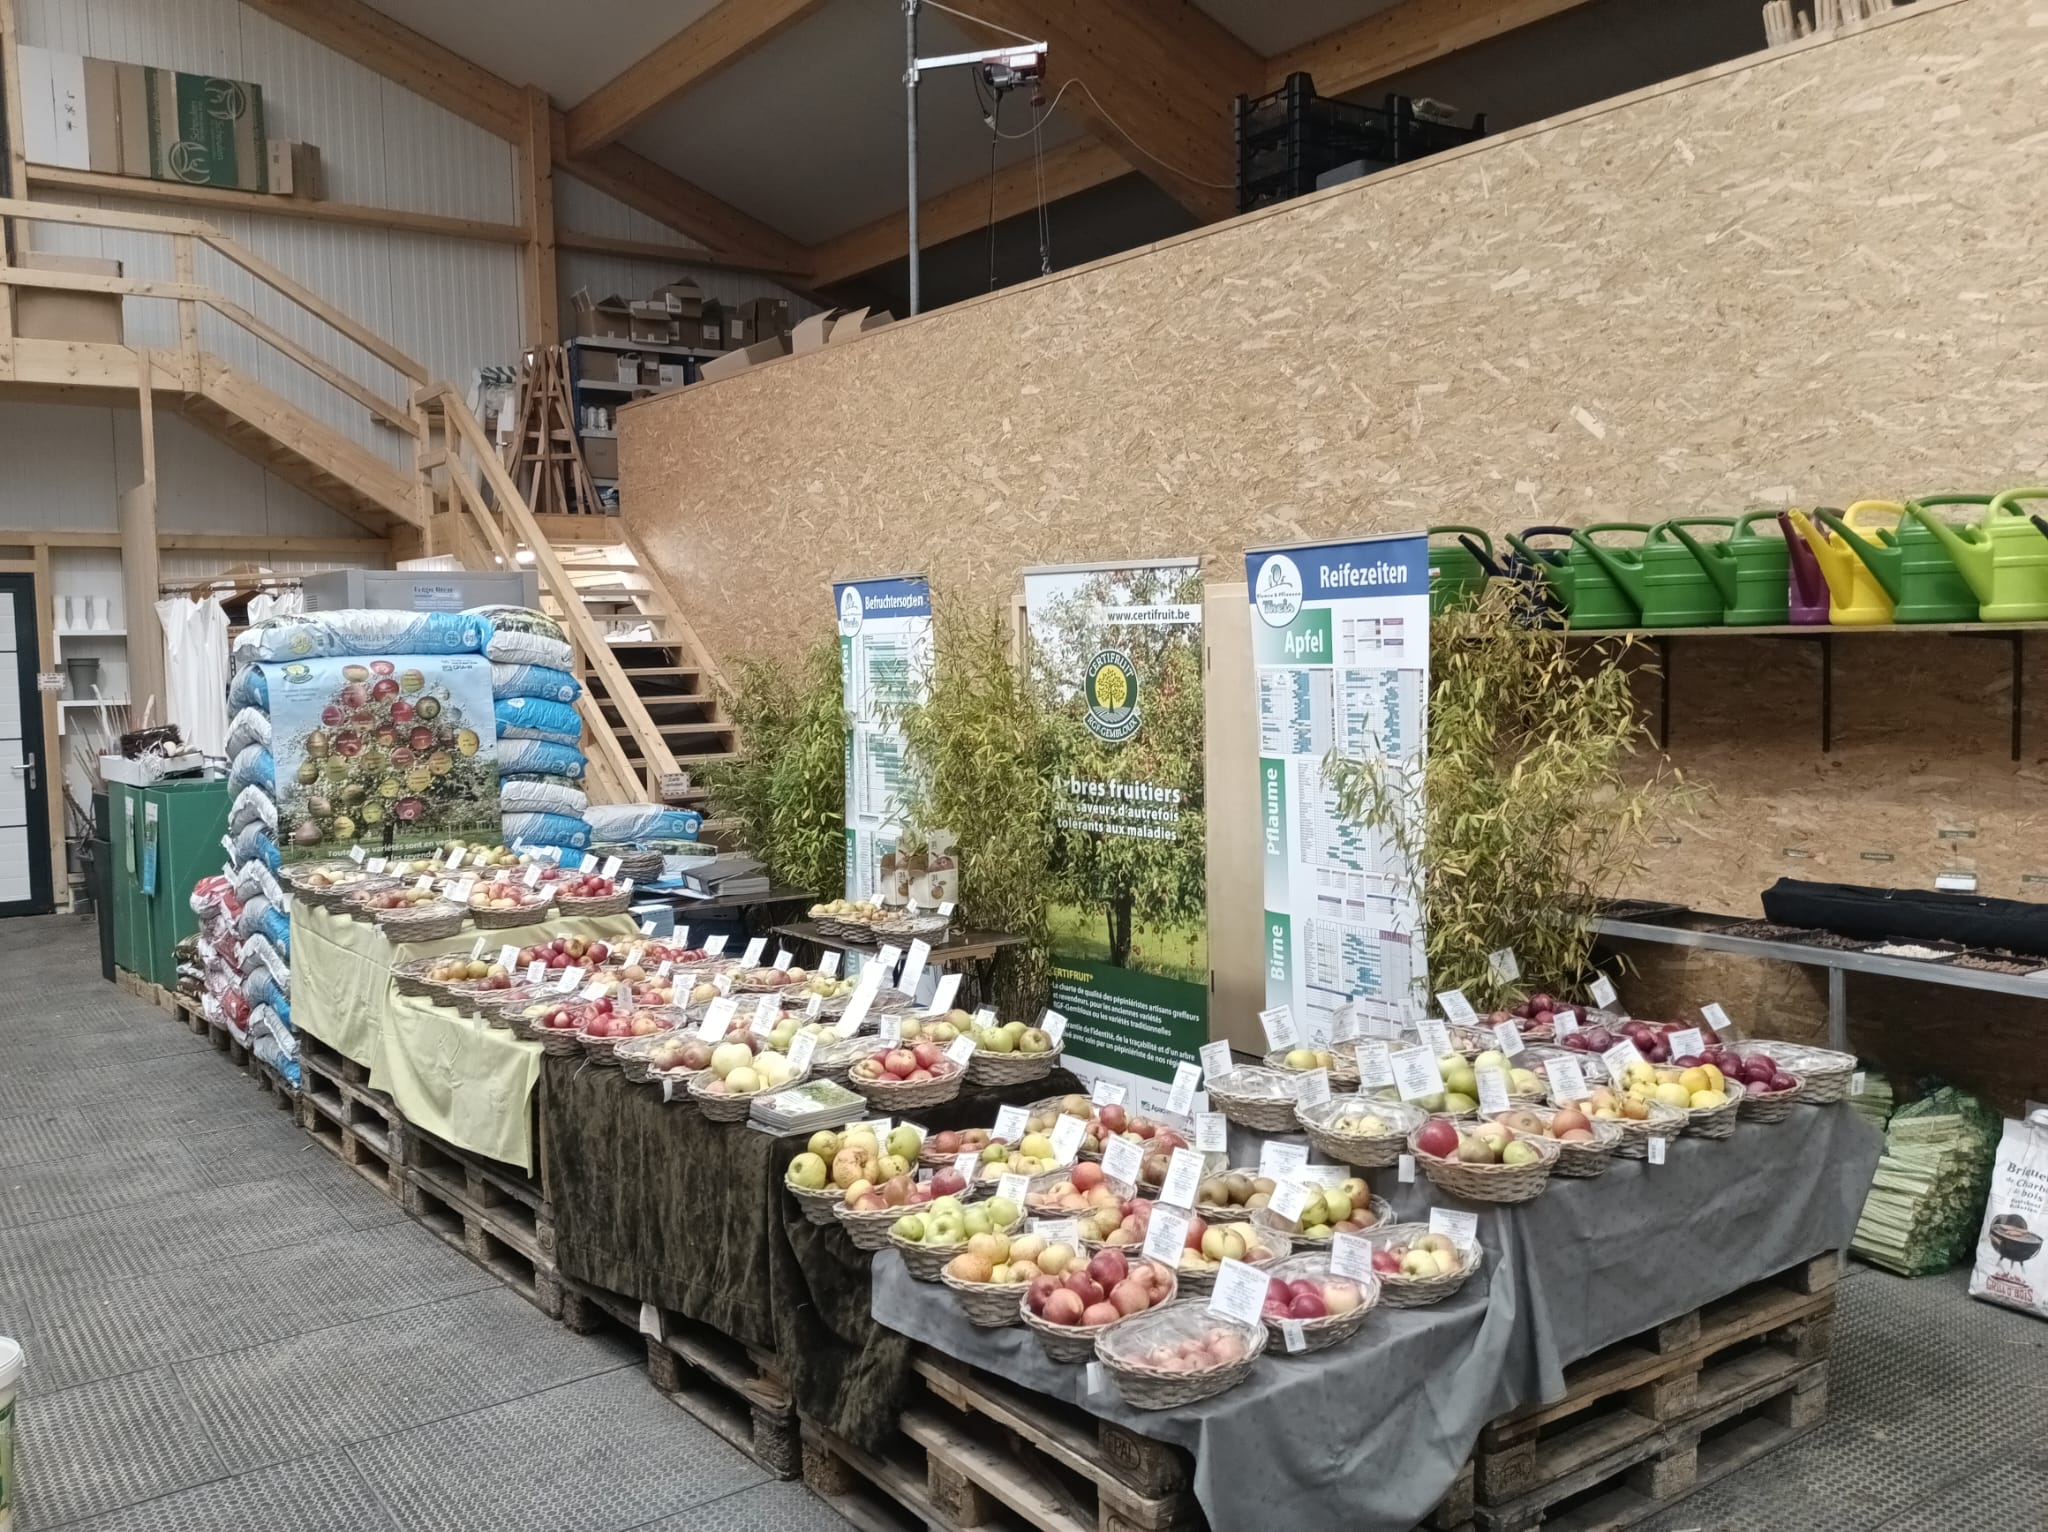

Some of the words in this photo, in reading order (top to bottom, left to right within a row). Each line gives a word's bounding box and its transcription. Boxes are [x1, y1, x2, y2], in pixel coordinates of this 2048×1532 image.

[1319, 561, 1408, 588] Reifezeiten
[864, 594, 924, 610] Befruchtersorten
[1107, 607, 1191, 621] www.certifruit.be
[1284, 628, 1323, 659] Apfel
[841, 644, 851, 684] Apfel
[1088, 652, 1135, 678] CERTIFRUIT
[1109, 779, 1181, 803] fruitiers
[1076, 803, 1115, 816] saveurs
[1265, 768, 1280, 856] Pflaume
[1105, 823, 1125, 835] aux
[1127, 825, 1177, 841] maladies
[404, 841, 422, 850] sont
[1270, 924, 1285, 981] Birne
[1059, 983, 1077, 993] charte
[1077, 986, 1084, 994] de
[1084, 989, 1103, 999] qualité
[1102, 993, 1113, 1001] des
[1149, 1004, 1172, 1016] artisans
[1172, 1010, 1200, 1022] greffeurs
[1089, 1000, 1103, 1009] pour
[1103, 1003, 1111, 1011] les
[1111, 1006, 1138, 1018] anciennes
[1139, 1012, 1162, 1024] variétés
[1100, 1012, 1108, 1020] les
[1108, 1015, 1130, 1026] variétés
[1130, 1020, 1172, 1036] traditionnelles
[1067, 1023, 1083, 1031] rantie
[1083, 1025, 1090, 1033] de
[1115, 1033, 1123, 1042] de
[1123, 1035, 1129, 1044] la
[1129, 1038, 1157, 1051] traçabilité
[1164, 1047, 1179, 1057] d'un
[1179, 1051, 1196, 1062] arbre
[1072, 1033, 1085, 1042] avec
[1085, 1036, 1096, 1045] soin
[1105, 1042, 1114, 1050] un
[1146, 1052, 1155, 1060] de
[1155, 1056, 1166, 1064] nos
[2021, 1190, 2042, 1202] bois
